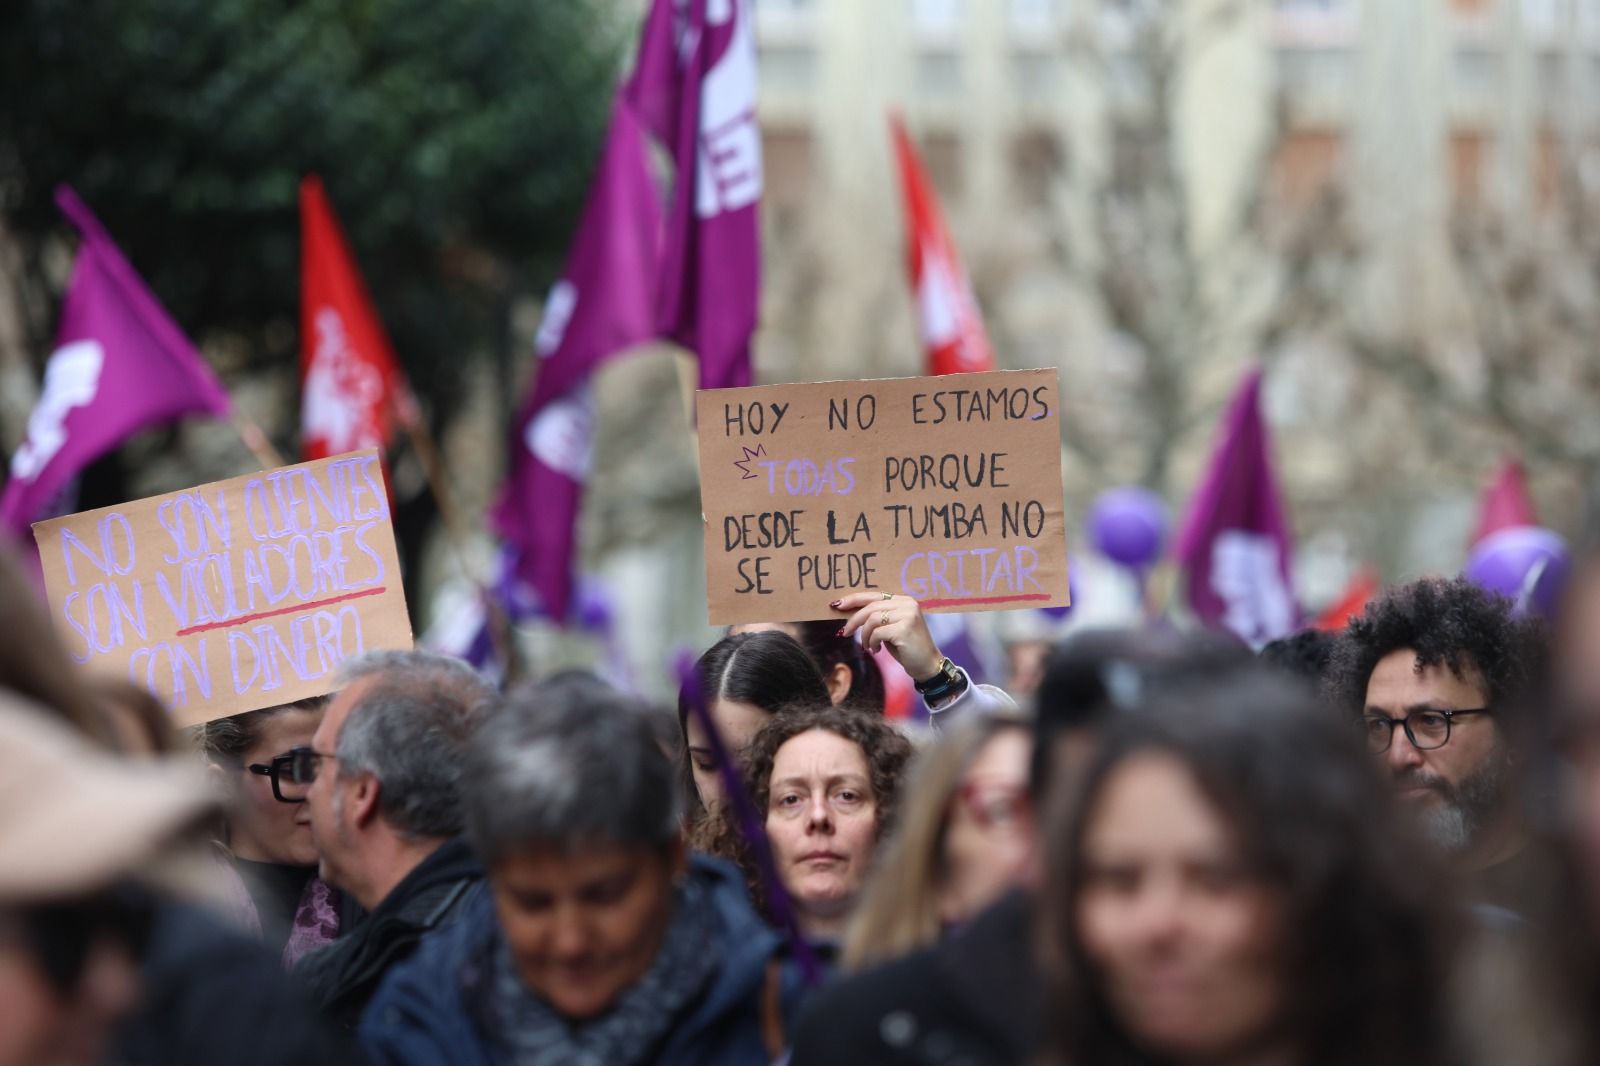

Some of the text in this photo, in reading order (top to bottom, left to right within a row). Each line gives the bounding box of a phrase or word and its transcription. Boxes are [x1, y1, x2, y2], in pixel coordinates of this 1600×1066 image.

[725, 386, 1048, 436] HOY NO ESTAMOS
[758, 453, 1010, 496] TODAS PORQUE
[60, 454, 389, 585] NO SON CLIENTES
[724, 500, 1045, 552] DESDE LA TUMBA NO
[64, 521, 386, 664] SON VIOLADORES
[735, 547, 1043, 597] SE PUEDE GRITAR
[129, 605, 364, 712] CON DINERO
